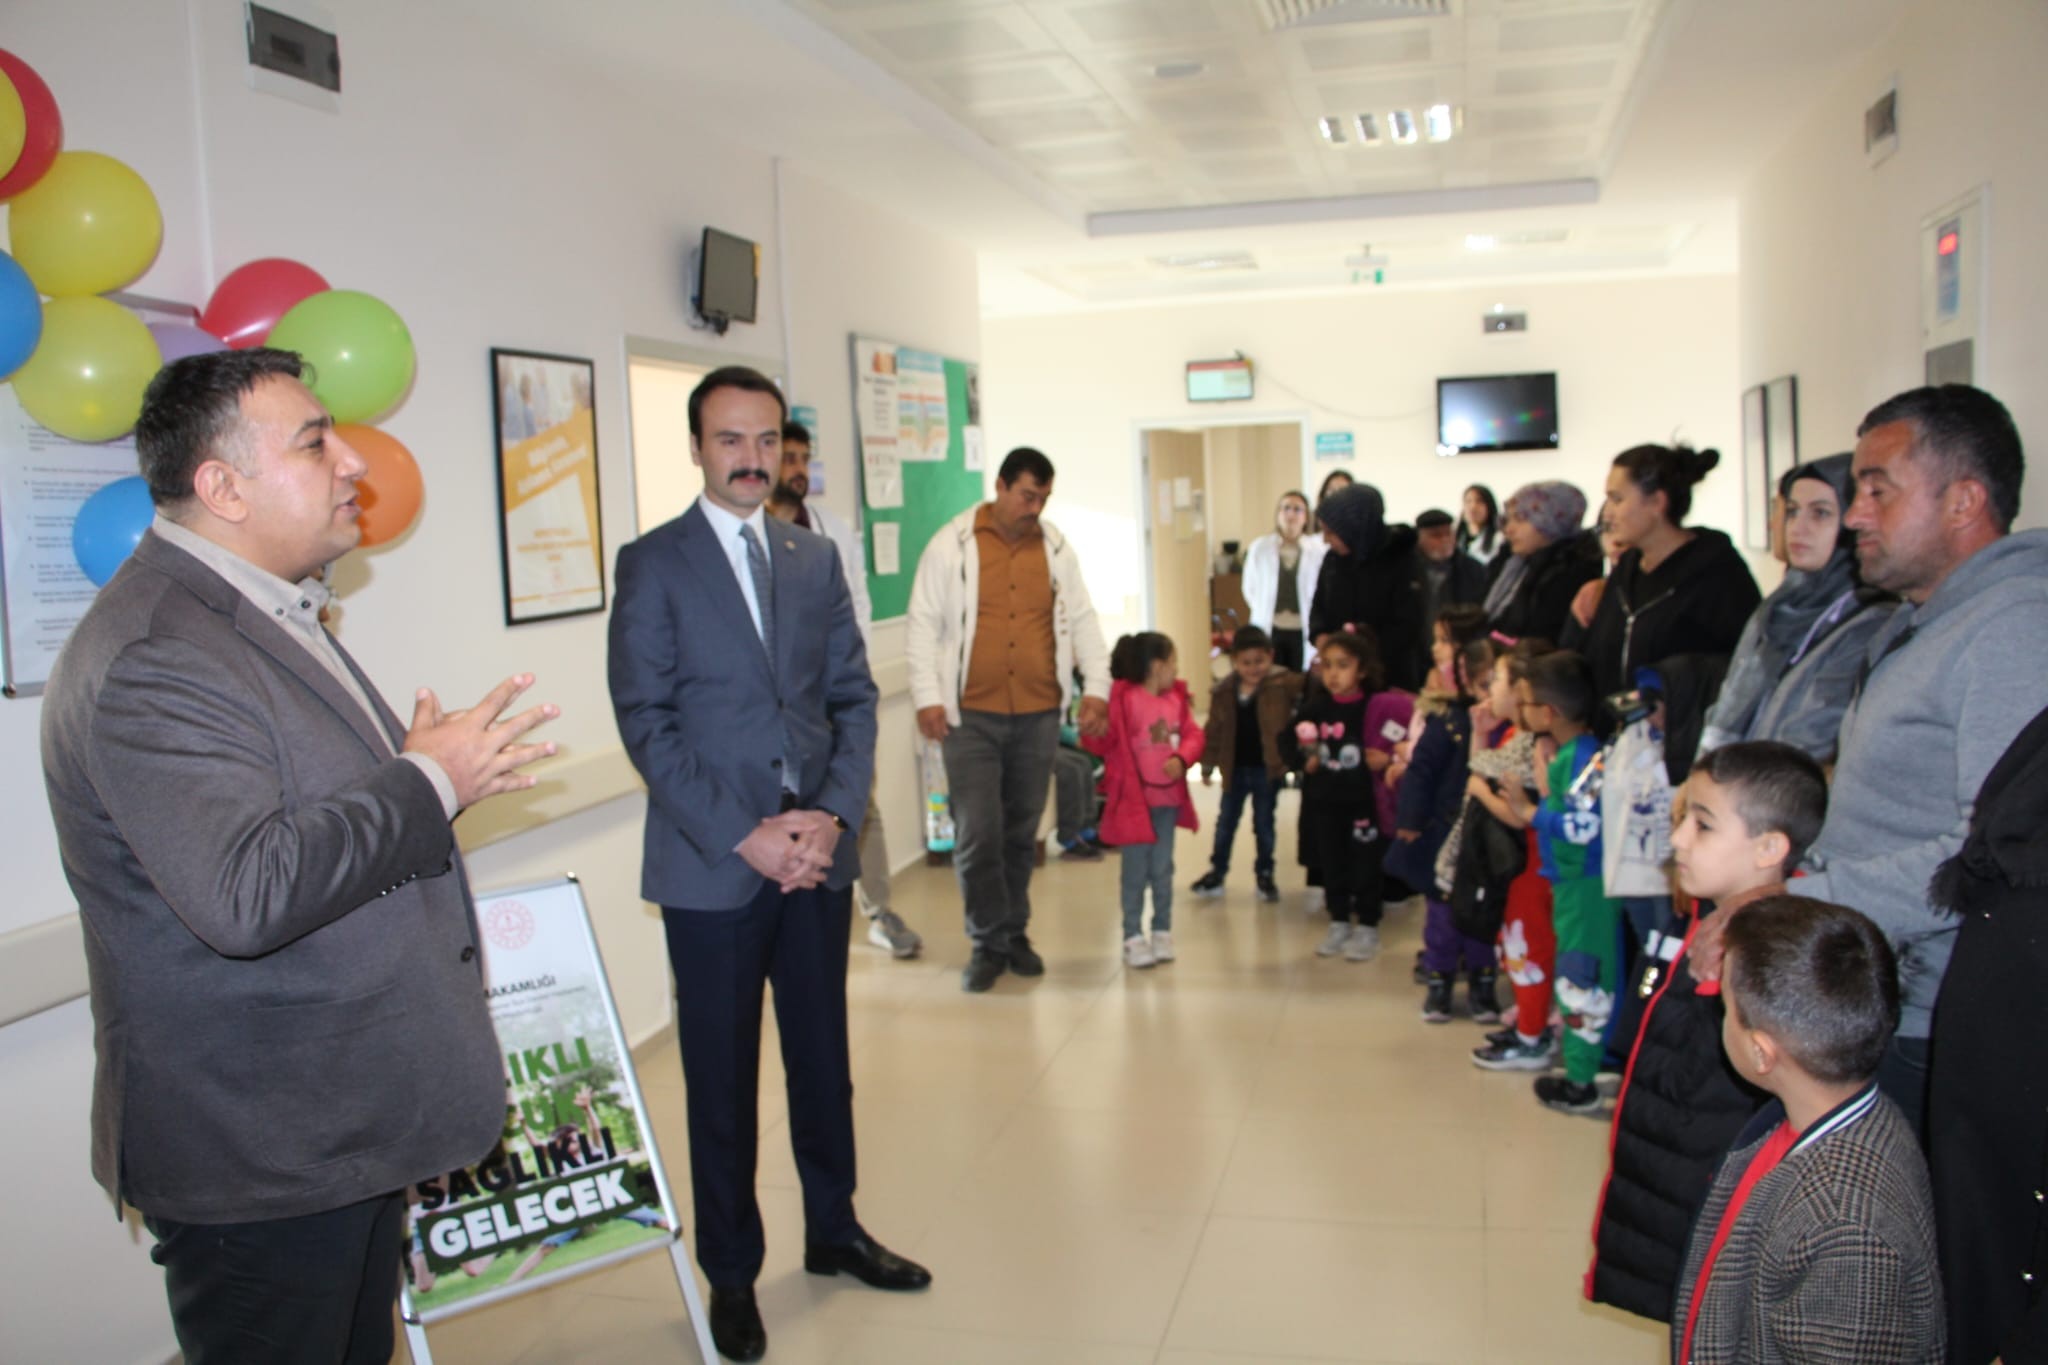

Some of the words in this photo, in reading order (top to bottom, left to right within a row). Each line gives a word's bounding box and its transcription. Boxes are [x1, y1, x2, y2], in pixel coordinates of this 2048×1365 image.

[486, 973, 556, 998] AKAMLIĞI
[508, 1037, 593, 1086] IKLI
[429, 1168, 634, 1258] GELECEK
